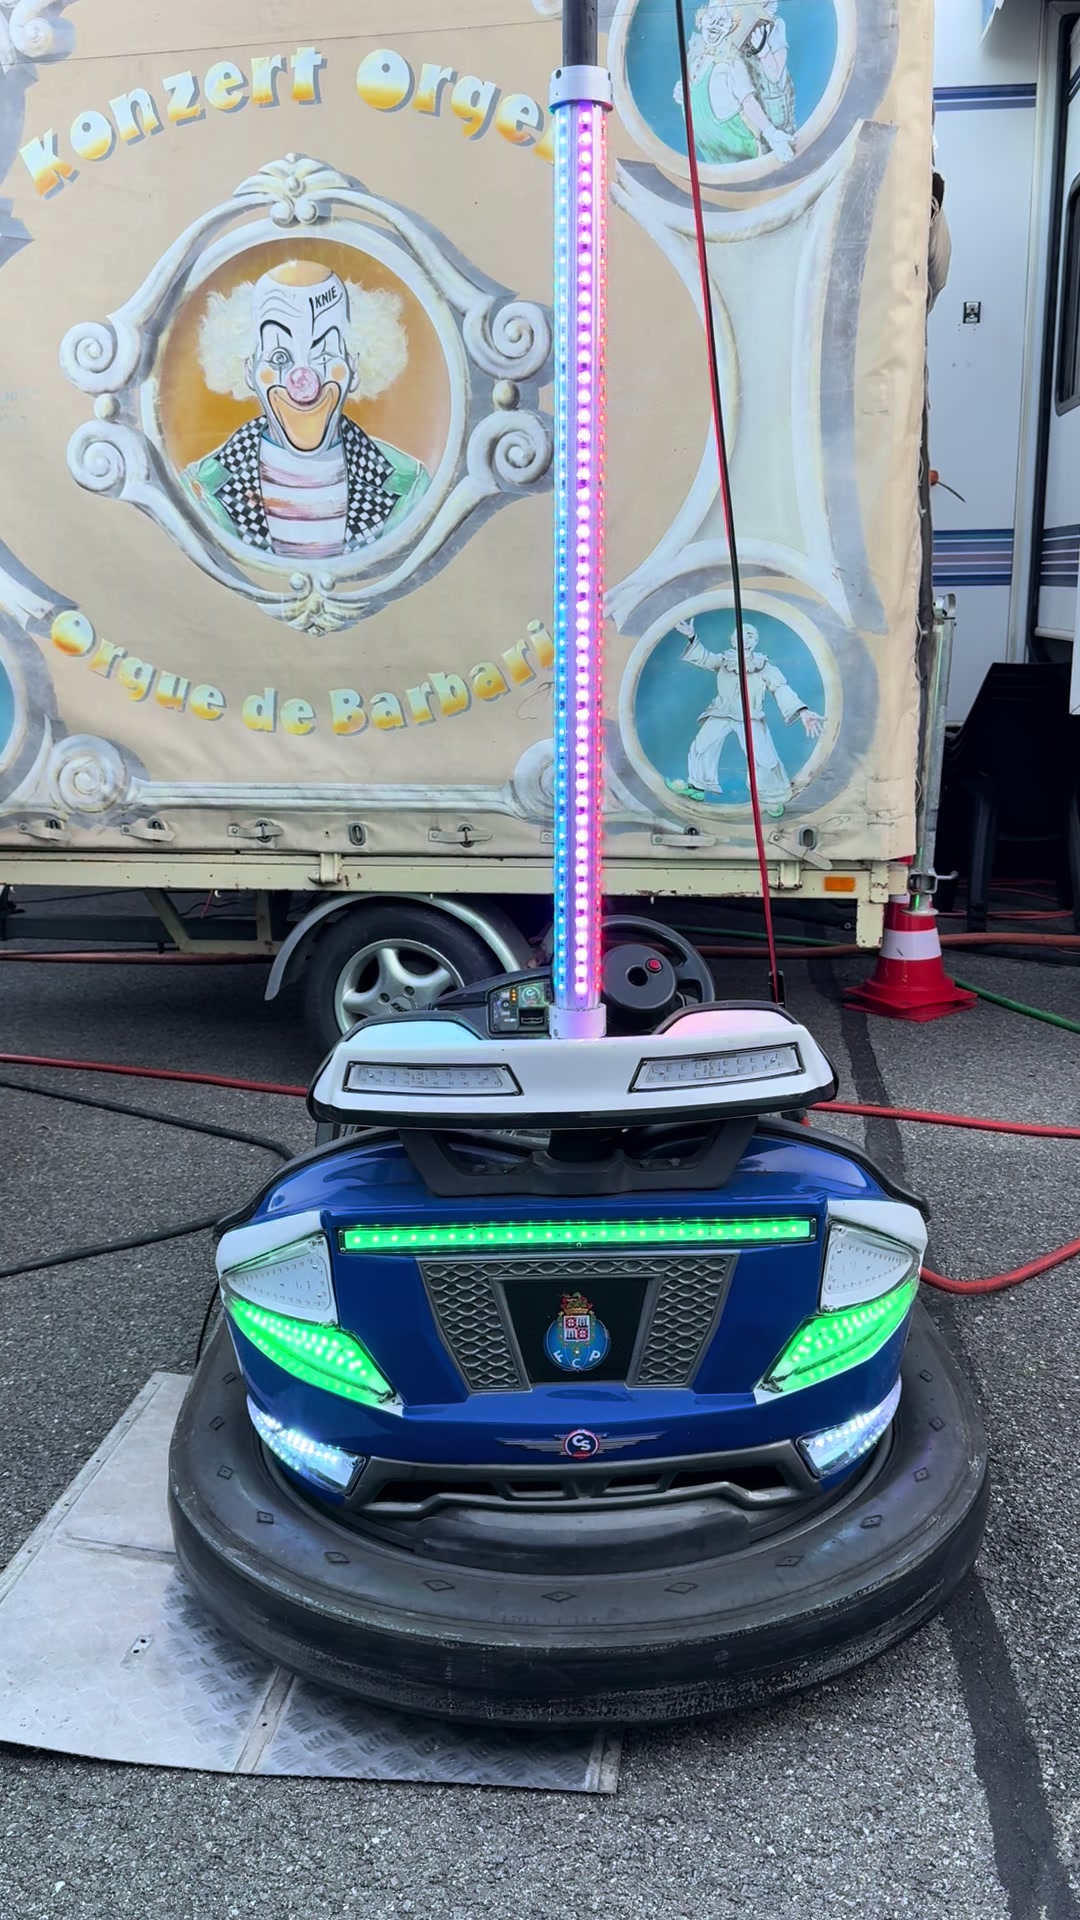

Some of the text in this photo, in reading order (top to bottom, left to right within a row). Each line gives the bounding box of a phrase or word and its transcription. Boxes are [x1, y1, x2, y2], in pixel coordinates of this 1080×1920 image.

[18, 46, 328, 198] Konzert
[315, 285, 338, 309] KNIE
[51, 609, 227, 721] Orgue
[242, 687, 316, 736] de
[571, 1434, 592, 1452] CS
